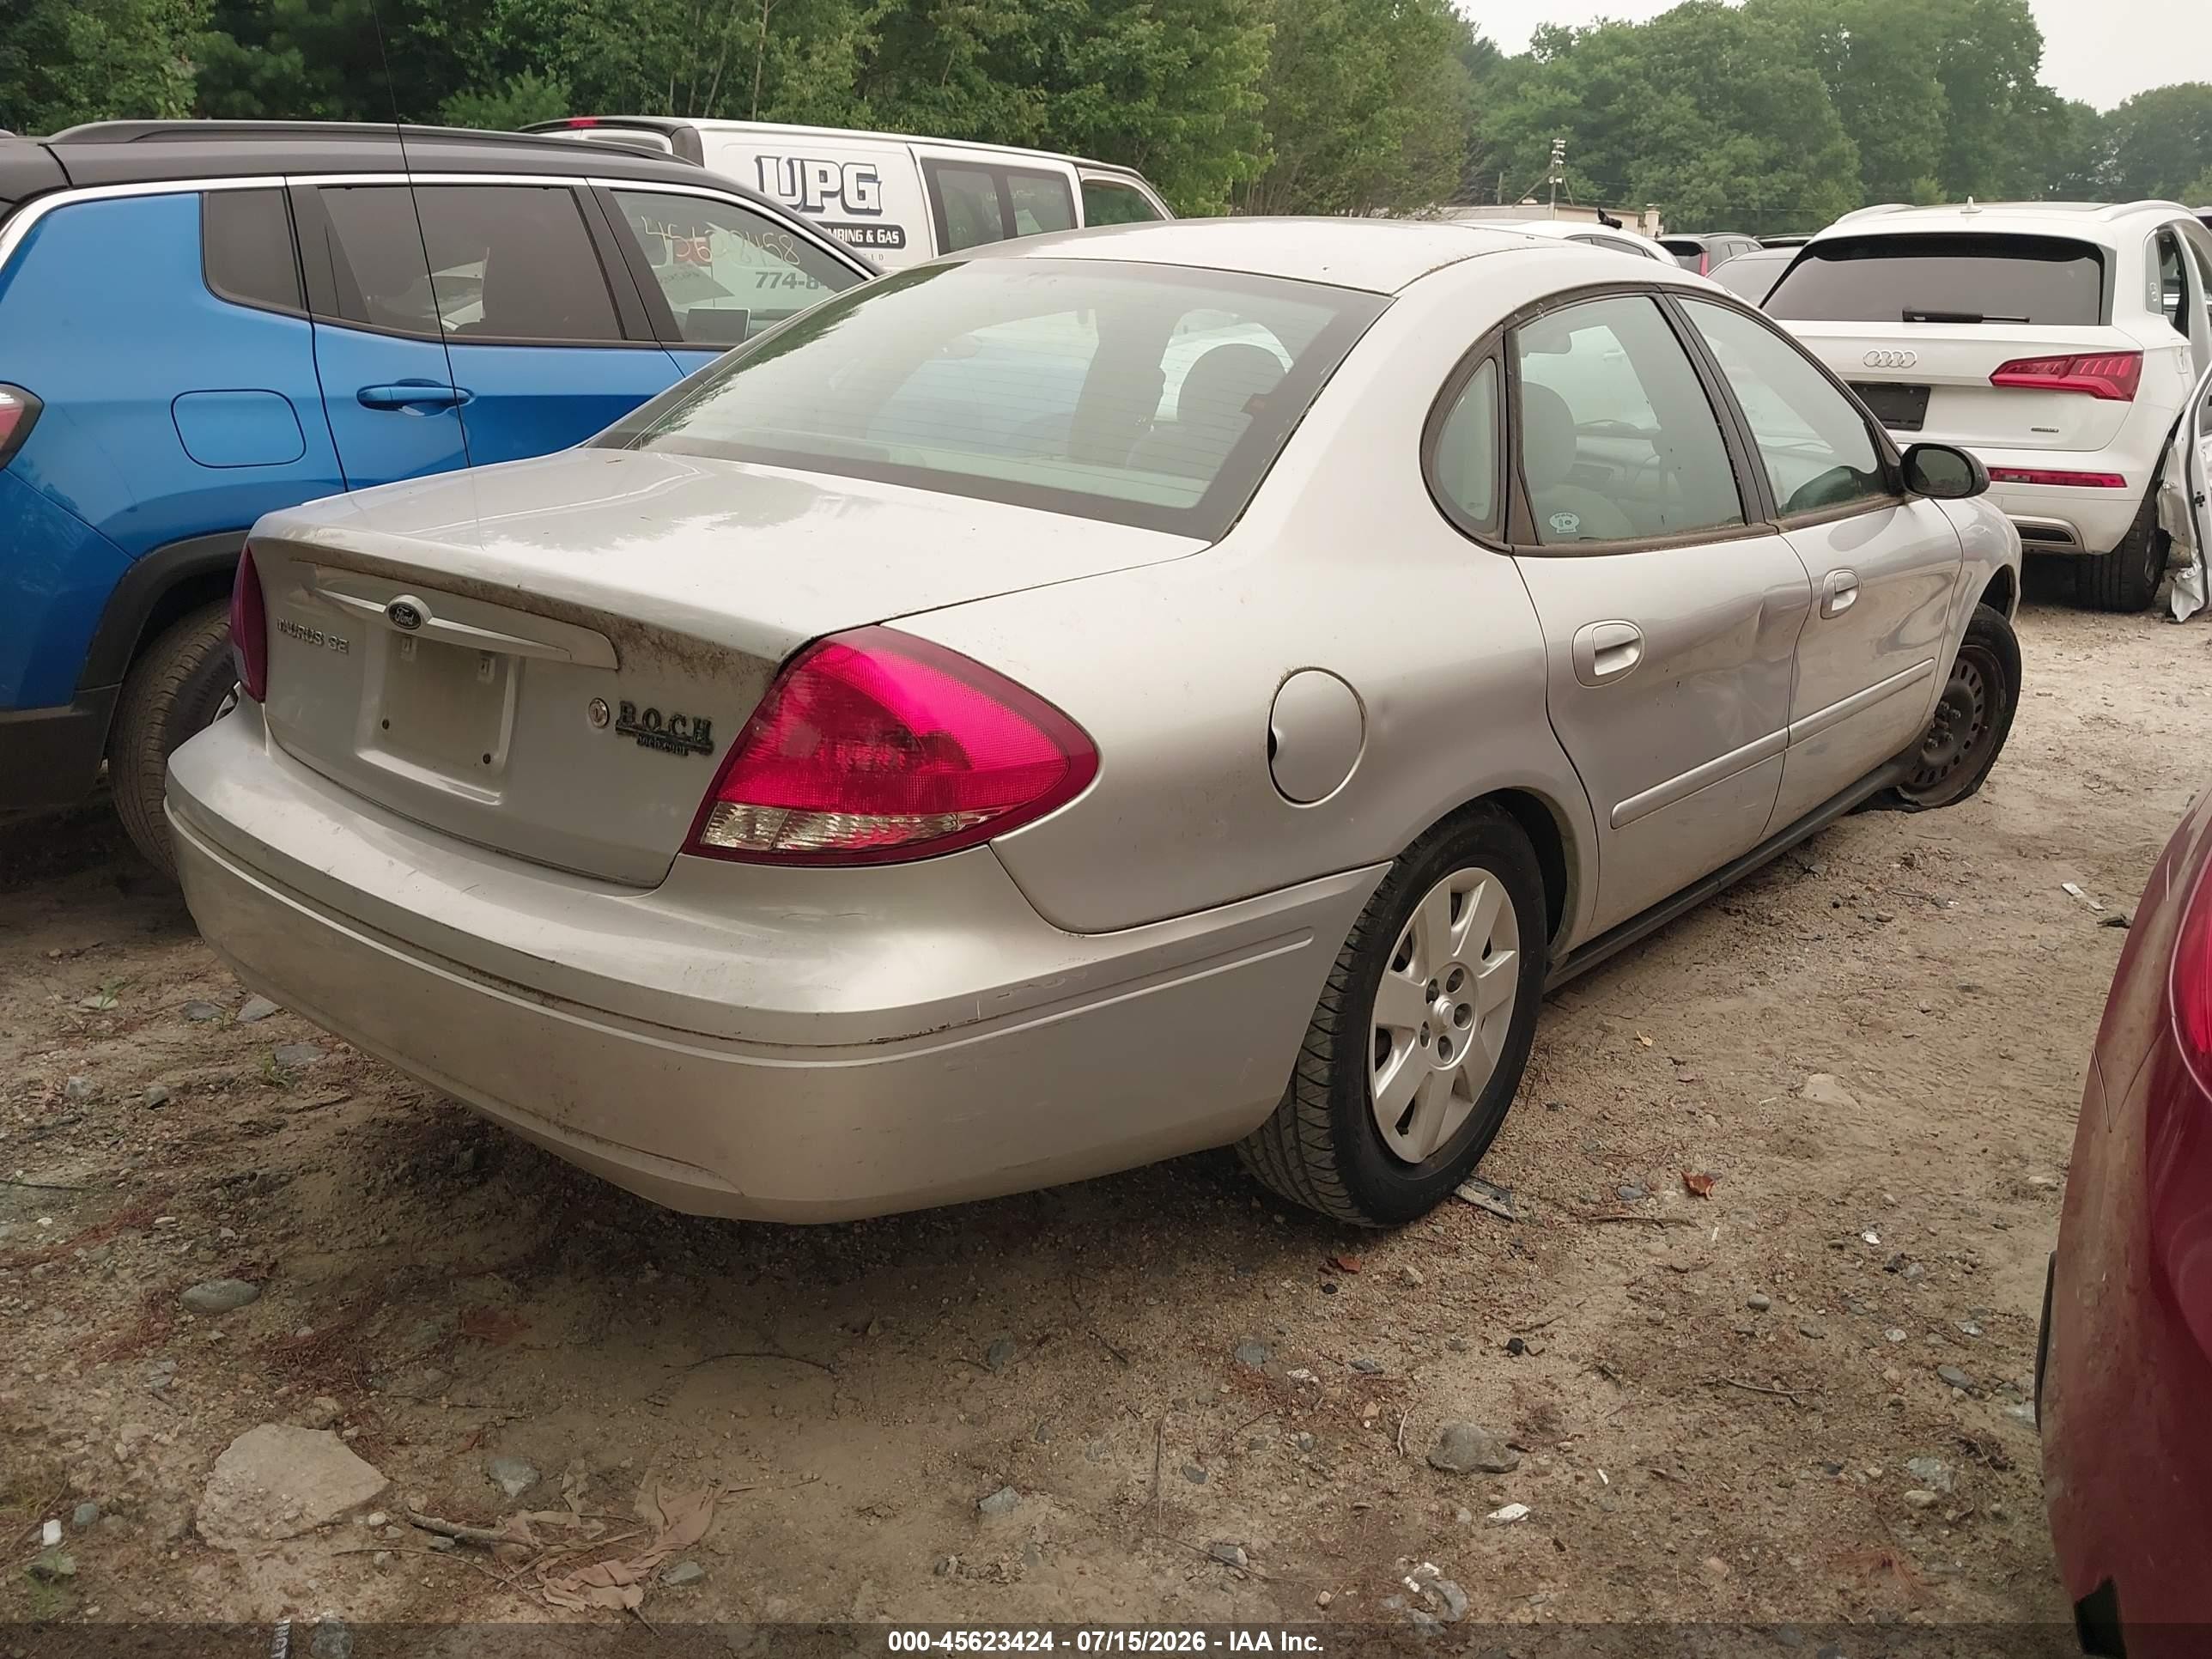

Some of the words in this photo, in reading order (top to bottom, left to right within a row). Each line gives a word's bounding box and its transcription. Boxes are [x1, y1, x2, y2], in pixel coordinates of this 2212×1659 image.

[754, 155, 884, 216] UPG
[825, 228, 864, 242] MBING
[866, 229, 875, 243] &
[877, 228, 900, 244] GAS
[394, 606, 415, 626] Ford
[276, 617, 325, 646] TAURUS
[328, 635, 350, 653] SE
[619, 700, 713, 743] BOCH
